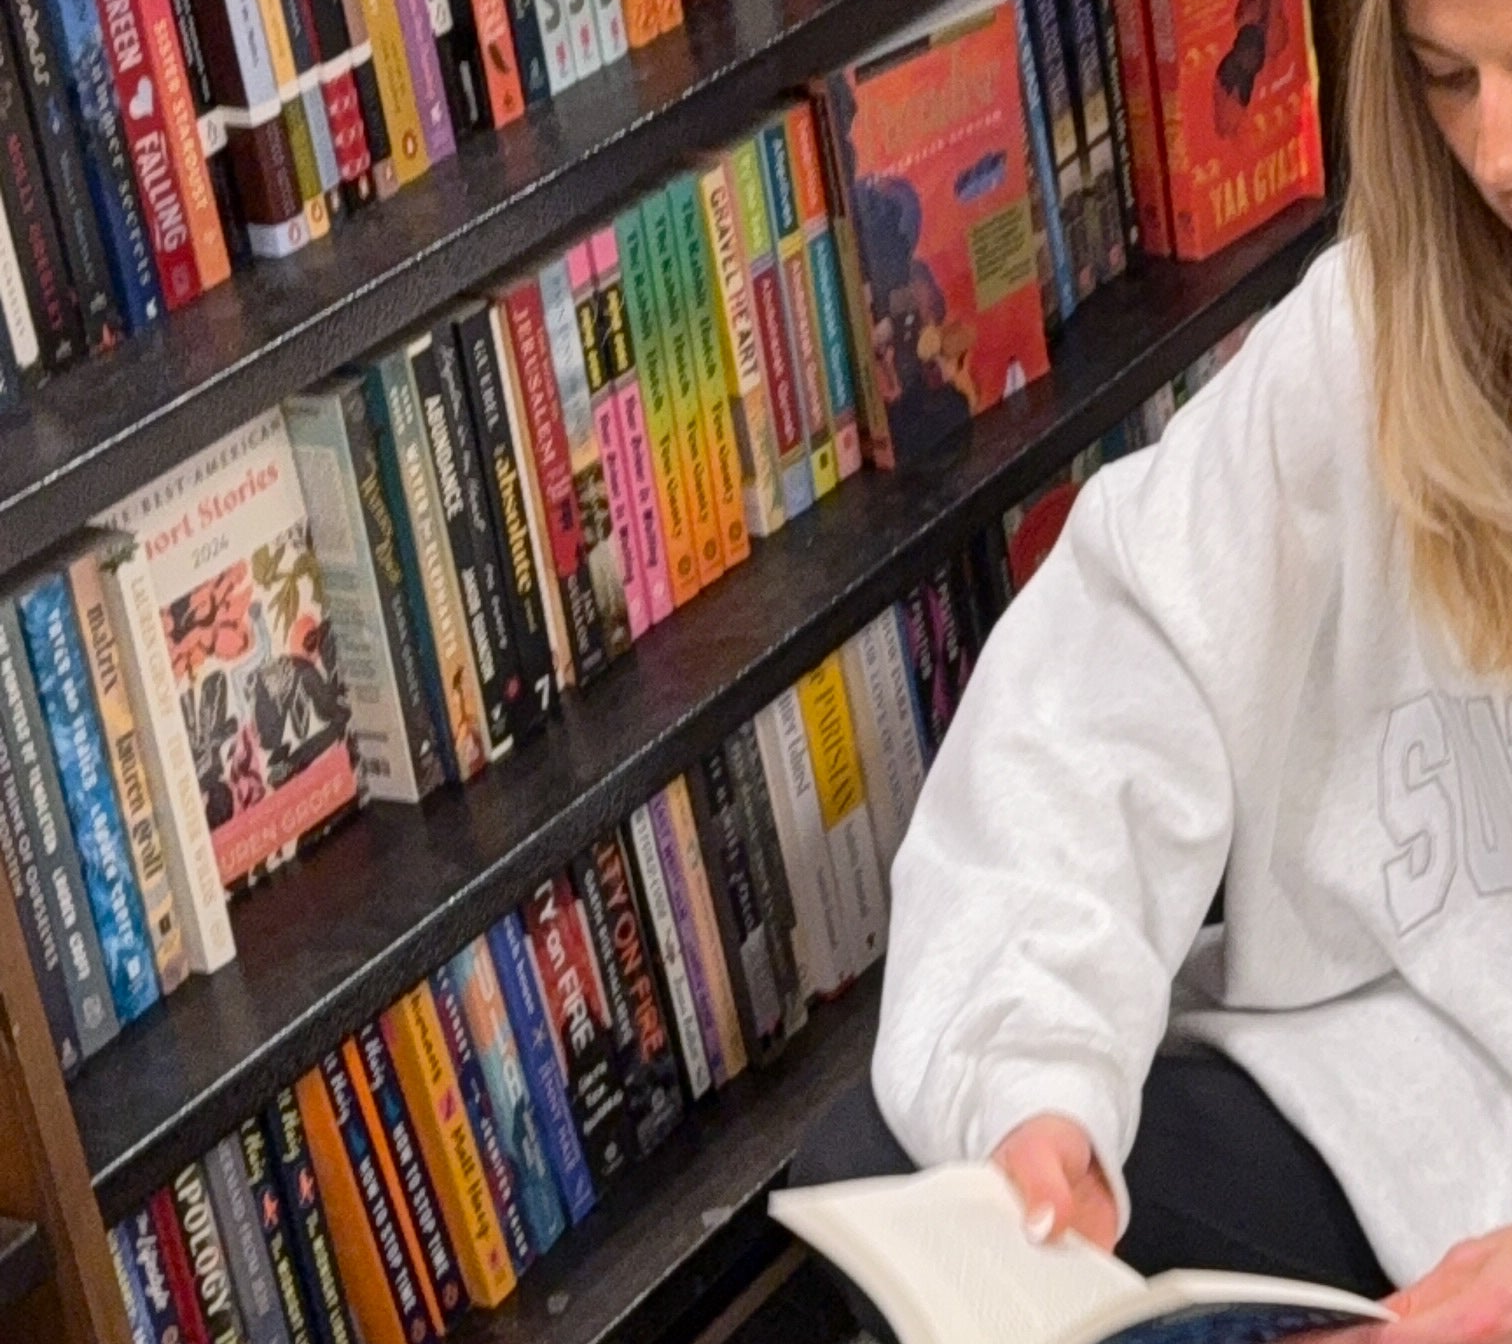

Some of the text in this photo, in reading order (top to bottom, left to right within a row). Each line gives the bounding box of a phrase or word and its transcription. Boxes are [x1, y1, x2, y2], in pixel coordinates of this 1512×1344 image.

[129, 131, 189, 254] FALLING
[650, 214, 672, 255] The
[678, 198, 698, 235] The
[1209, 136, 1308, 228] YAA GYASI
[710, 187, 758, 380] GRAVEL HEART
[514, 305, 555, 463] JERUSALEM
[196, 461, 279, 519] Stories
[424, 393, 464, 520] ABUNDANCE
[491, 455, 538, 594] absolute
[84, 604, 124, 695] matrix
[423, 544, 460, 658] ELEPHANTS
[110, 730, 152, 818] lauren
[810, 689, 856, 817] PARISIAN
[555, 967, 595, 1055] FIRE
[609, 912, 664, 1063] ON FIRE
[356, 1154, 419, 1316] HOW TO STOP TIME
[391, 1121, 452, 1280] HOW TO STOP TIME
